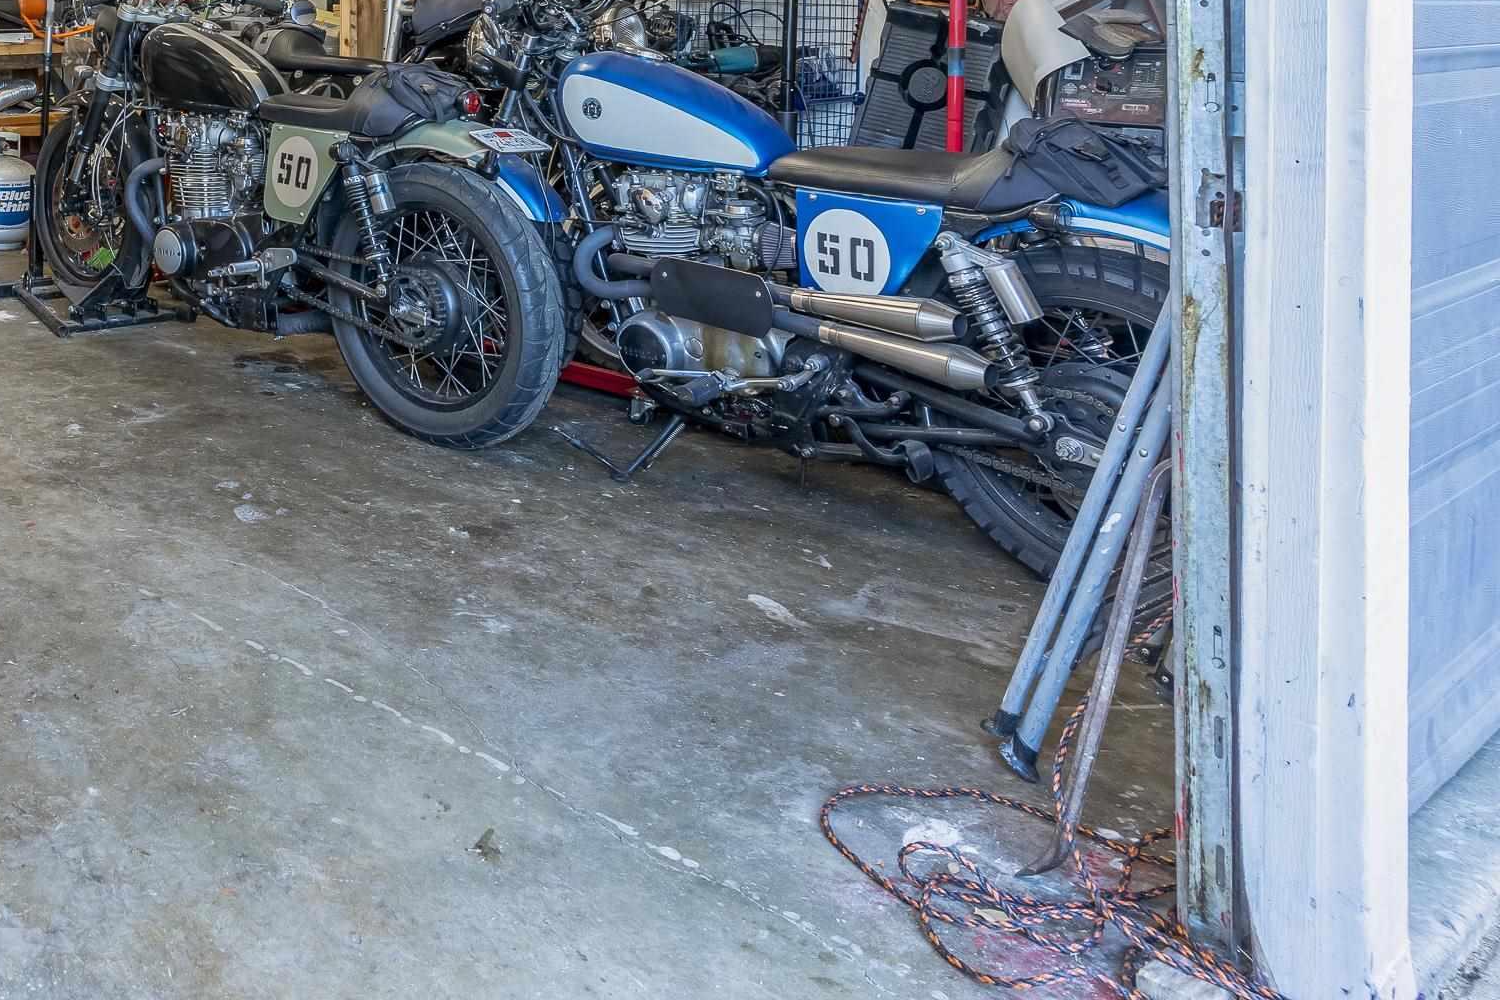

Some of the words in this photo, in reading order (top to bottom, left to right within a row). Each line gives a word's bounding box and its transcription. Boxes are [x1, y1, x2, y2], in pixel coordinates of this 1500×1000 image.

[277, 152, 312, 190] 50
[0, 190, 31, 201] Blue
[817, 231, 875, 282] 50
